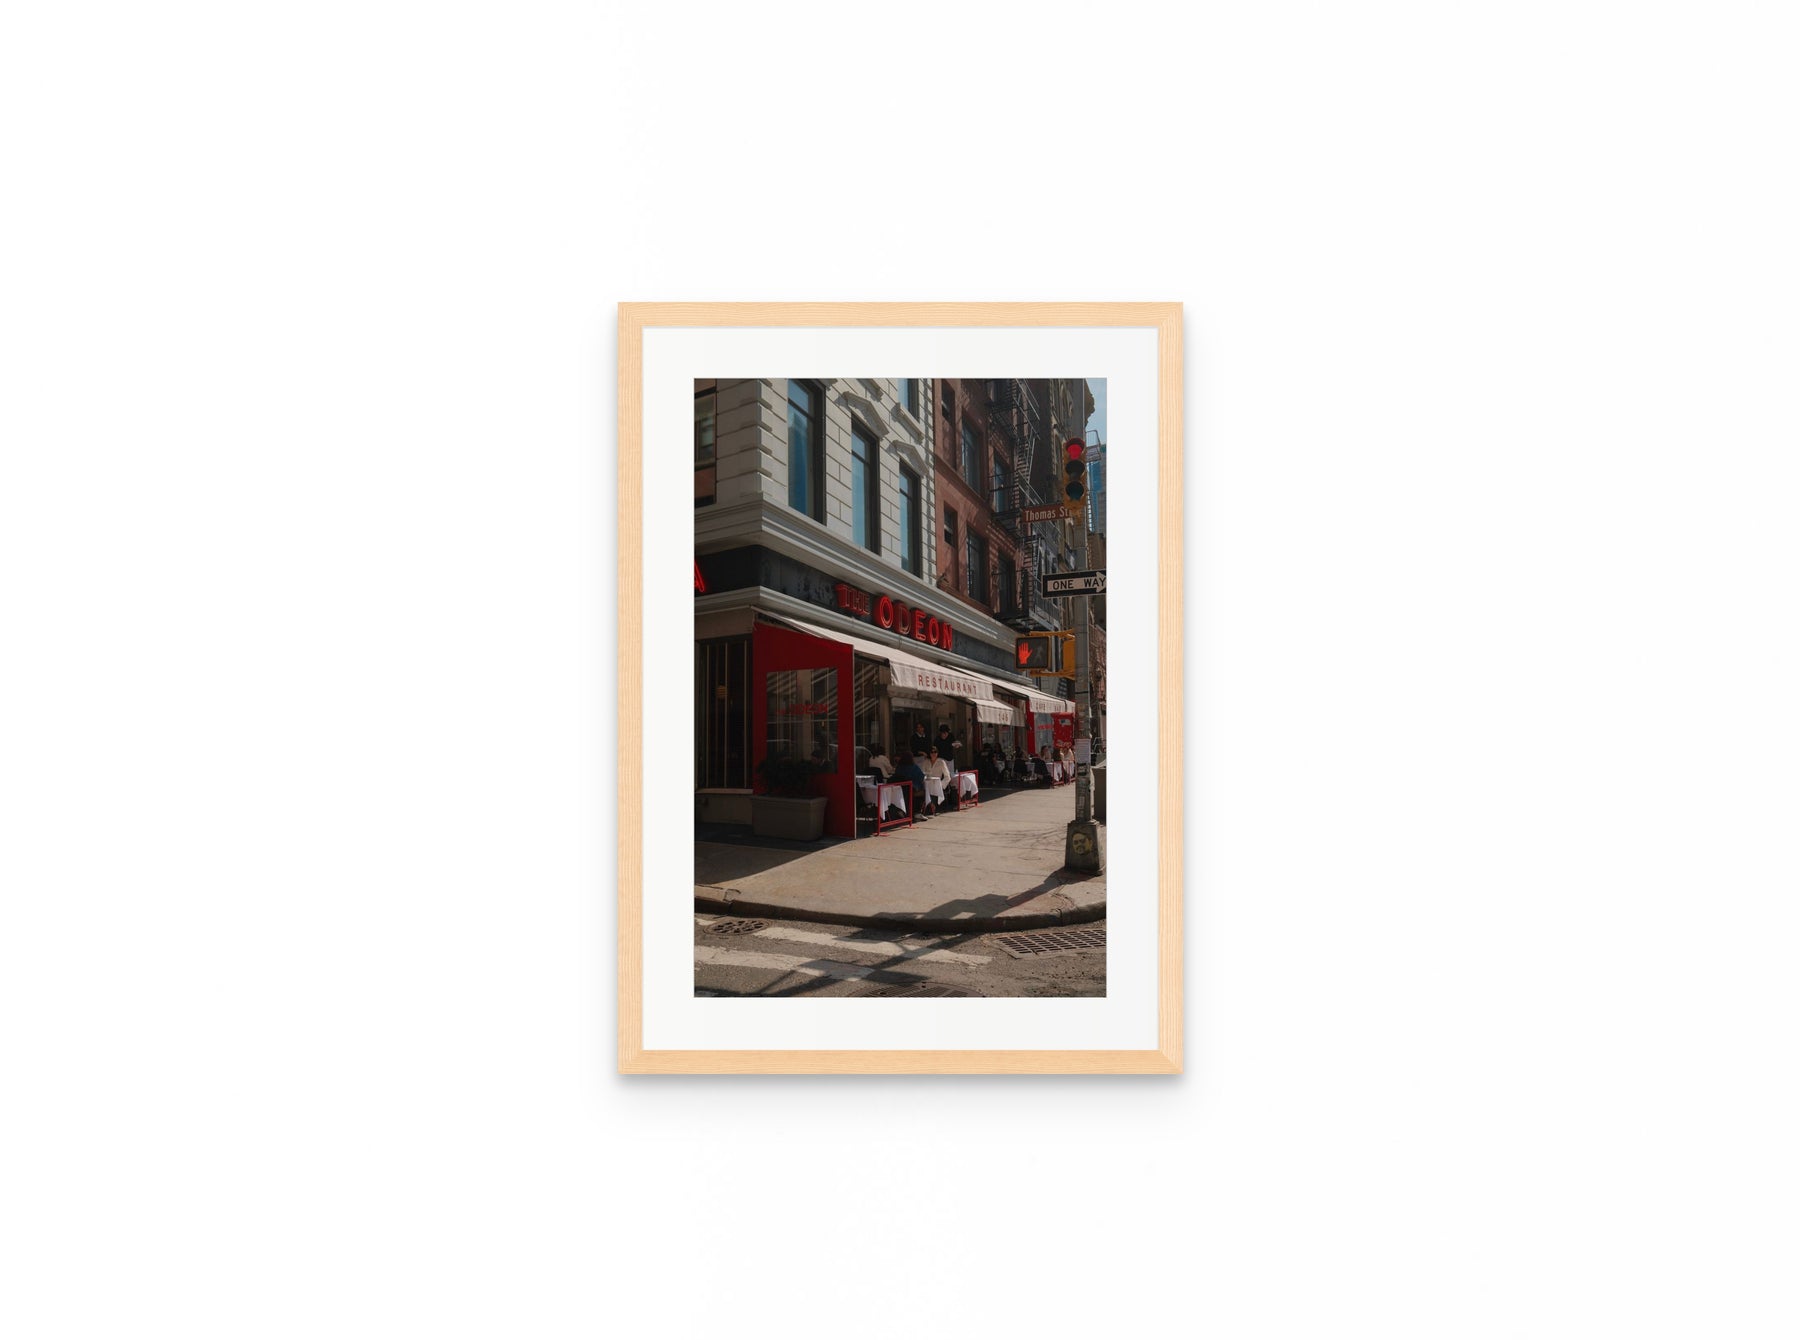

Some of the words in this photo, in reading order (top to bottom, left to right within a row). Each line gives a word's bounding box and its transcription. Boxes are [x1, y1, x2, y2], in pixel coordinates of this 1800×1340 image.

[1025, 509, 1056, 521] Thomas
[1052, 580, 1074, 590] ONE
[1083, 577, 1106, 588] WAY
[837, 584, 870, 616] THE
[875, 595, 954, 652] ODEON
[917, 674, 977, 695] RESTAURANT
